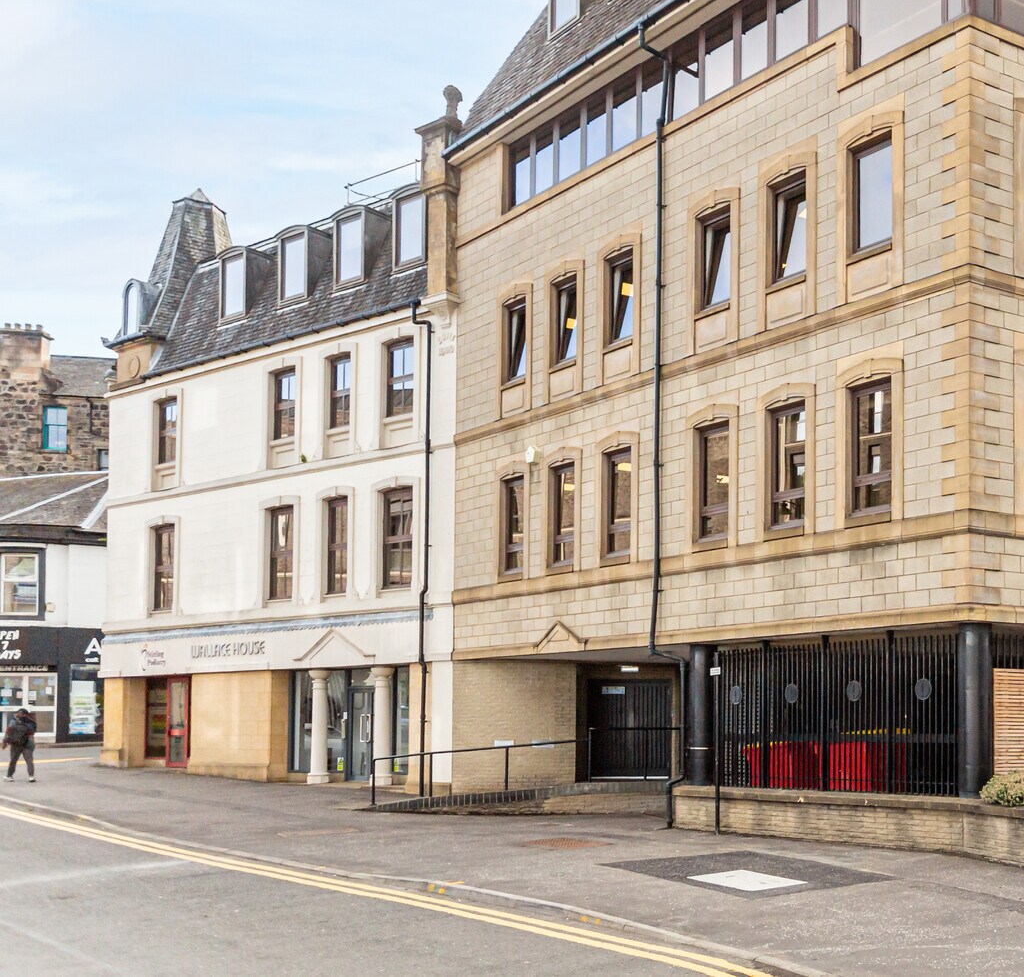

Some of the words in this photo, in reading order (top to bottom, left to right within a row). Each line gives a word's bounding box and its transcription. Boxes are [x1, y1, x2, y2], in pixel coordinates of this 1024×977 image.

[0, 630, 19, 640] PEN
[1, 641, 9, 650] 7
[191, 643, 231, 659] WALLACE
[232, 641, 266, 656] HOUSE
[0, 650, 21, 660] AYS
